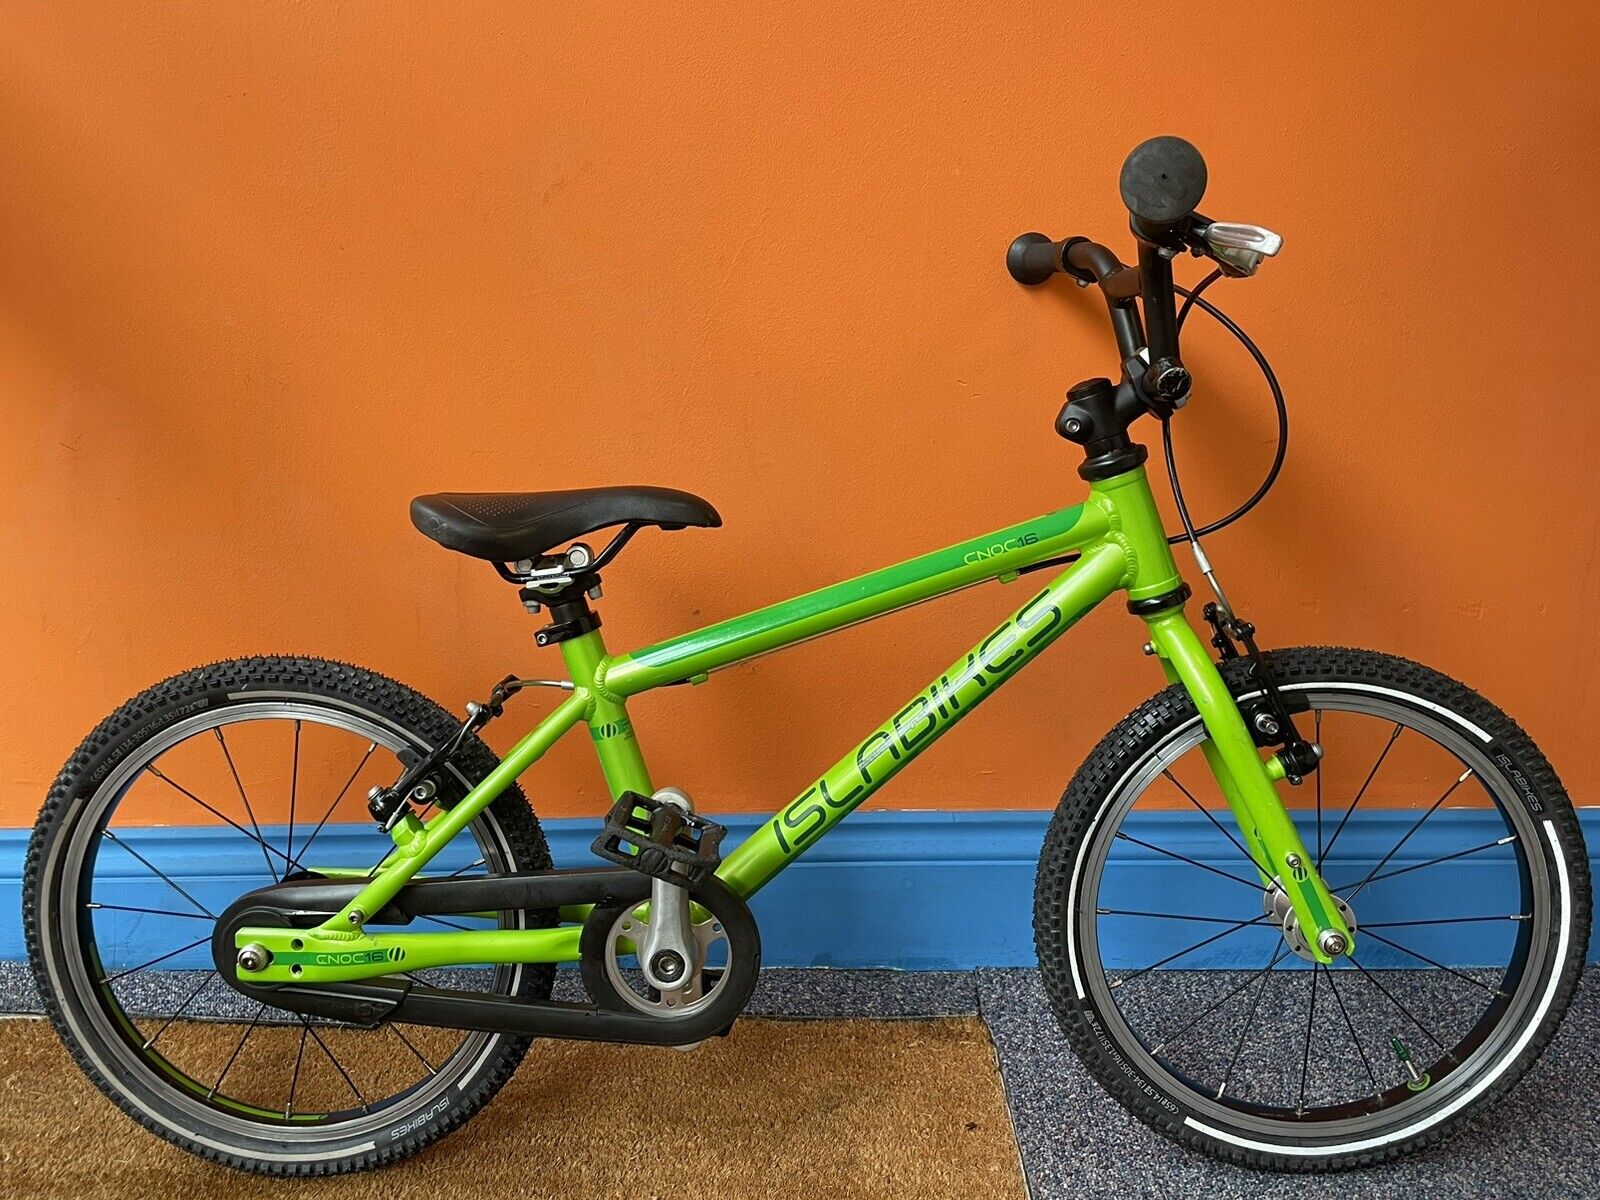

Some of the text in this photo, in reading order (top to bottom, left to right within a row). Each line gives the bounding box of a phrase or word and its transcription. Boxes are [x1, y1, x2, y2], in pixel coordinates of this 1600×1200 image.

[963, 532, 1039, 565] CNOC16
[773, 588, 1062, 854] ISLABIKES
[1495, 753, 1543, 812] ISLABIKES
[316, 953, 385, 965] CNOC16
[391, 1096, 450, 1141] ISLABIKES
